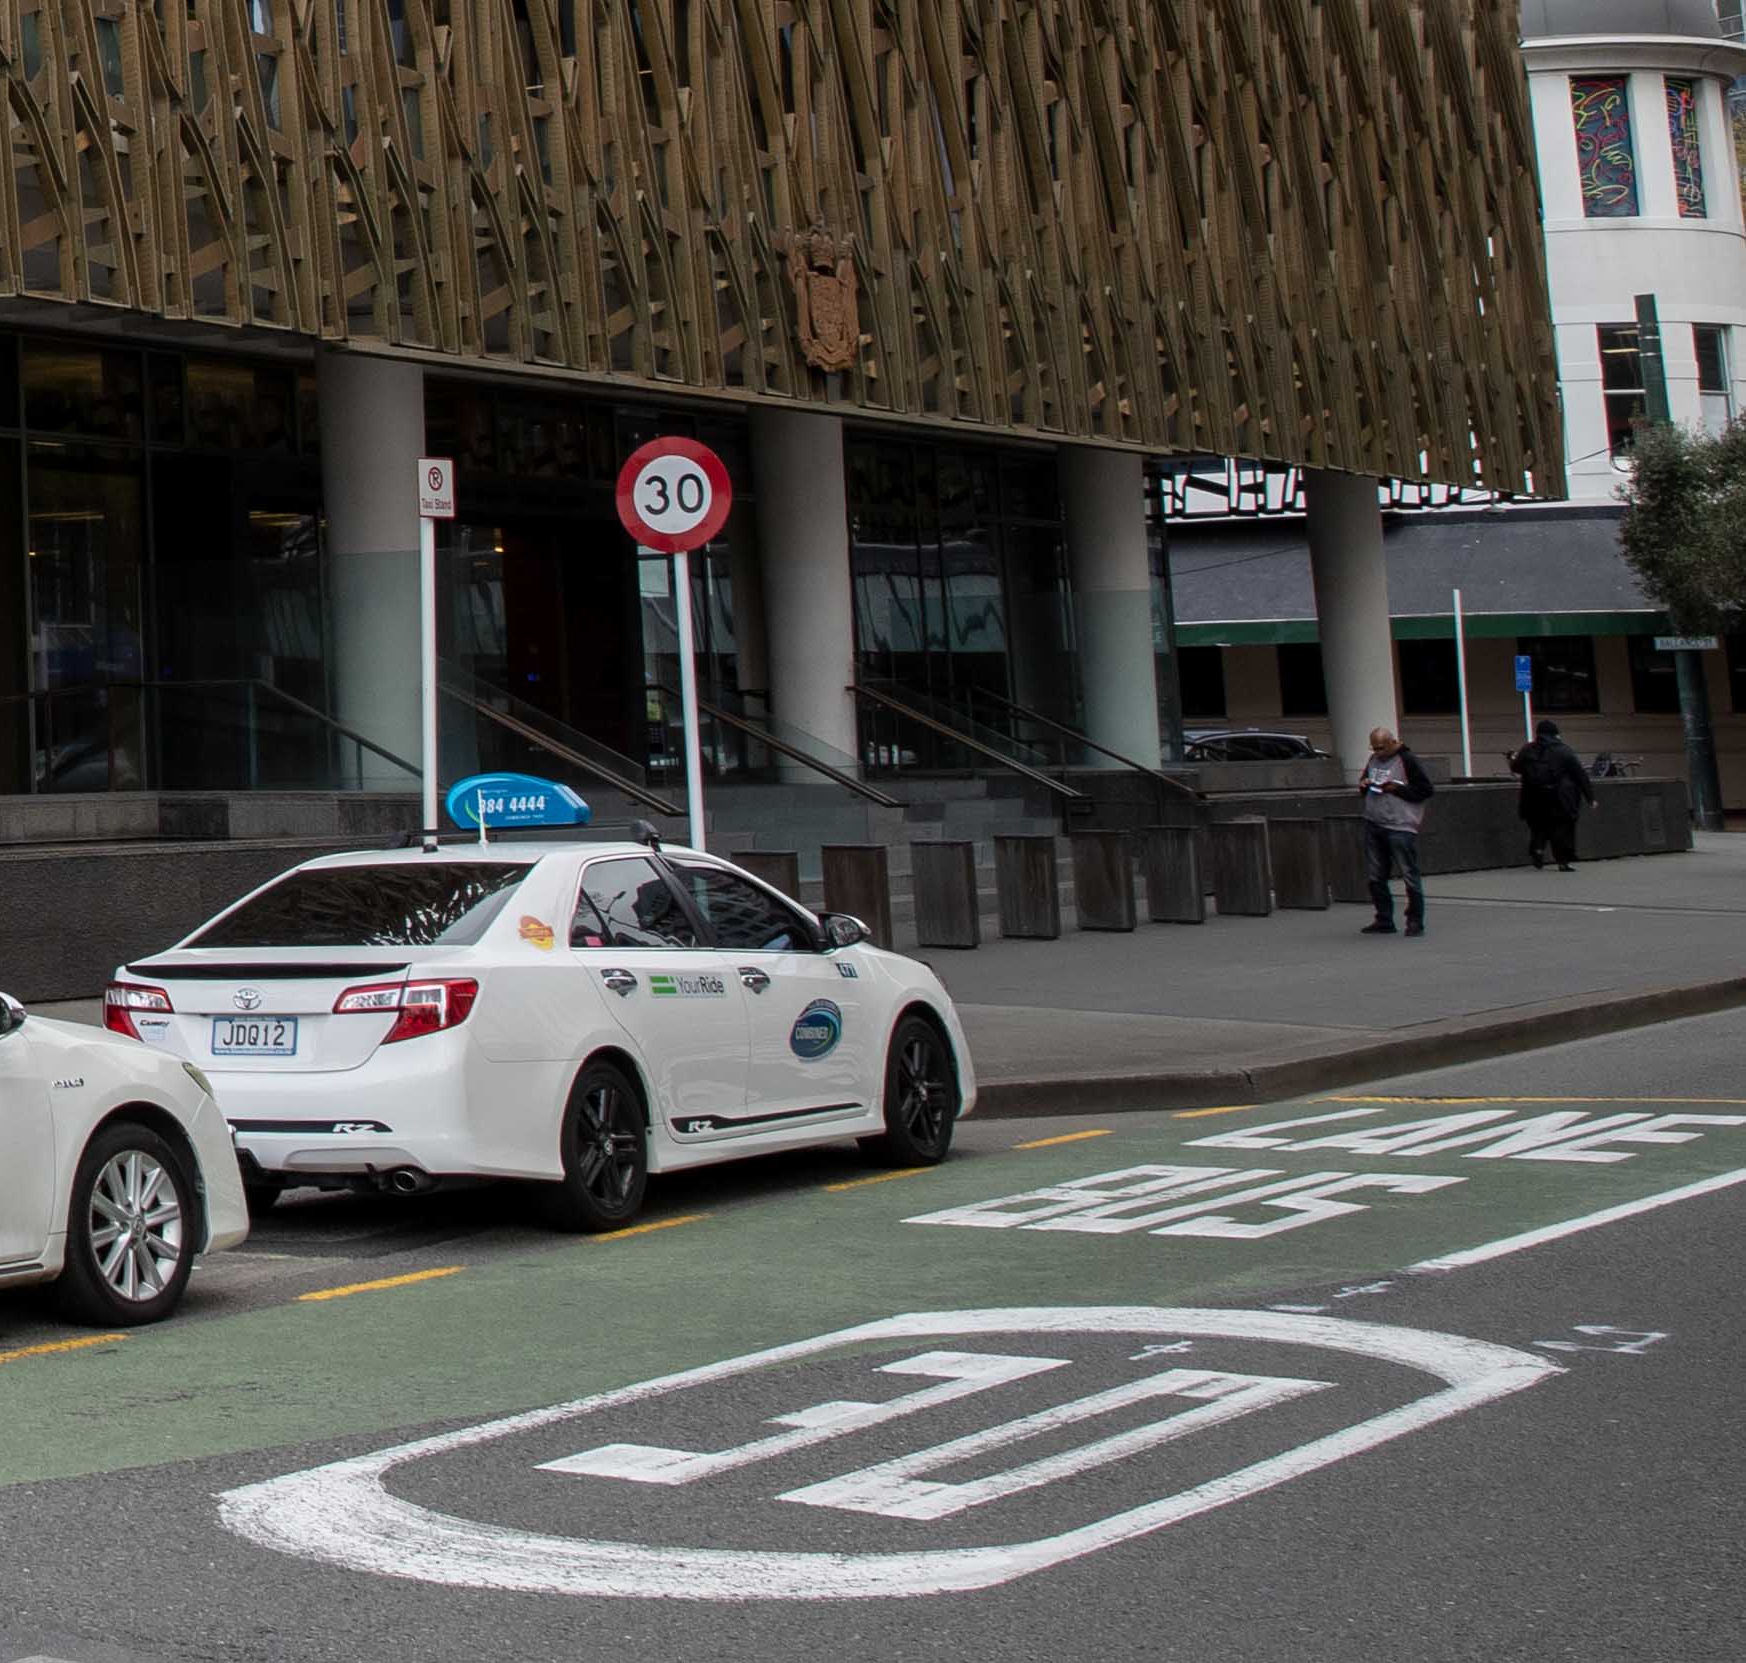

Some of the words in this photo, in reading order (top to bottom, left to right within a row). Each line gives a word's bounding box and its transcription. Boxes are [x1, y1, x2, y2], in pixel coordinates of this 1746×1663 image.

[644, 473, 704, 515] 30
[479, 798, 504, 814] 384
[509, 795, 545, 812] 4444
[676, 975, 725, 994] YourRide
[223, 1023, 285, 1046] JDQ12
[1181, 1107, 1746, 1163] LANE
[900, 1163, 1470, 1238] BUS
[532, 1349, 1340, 1521] 30
